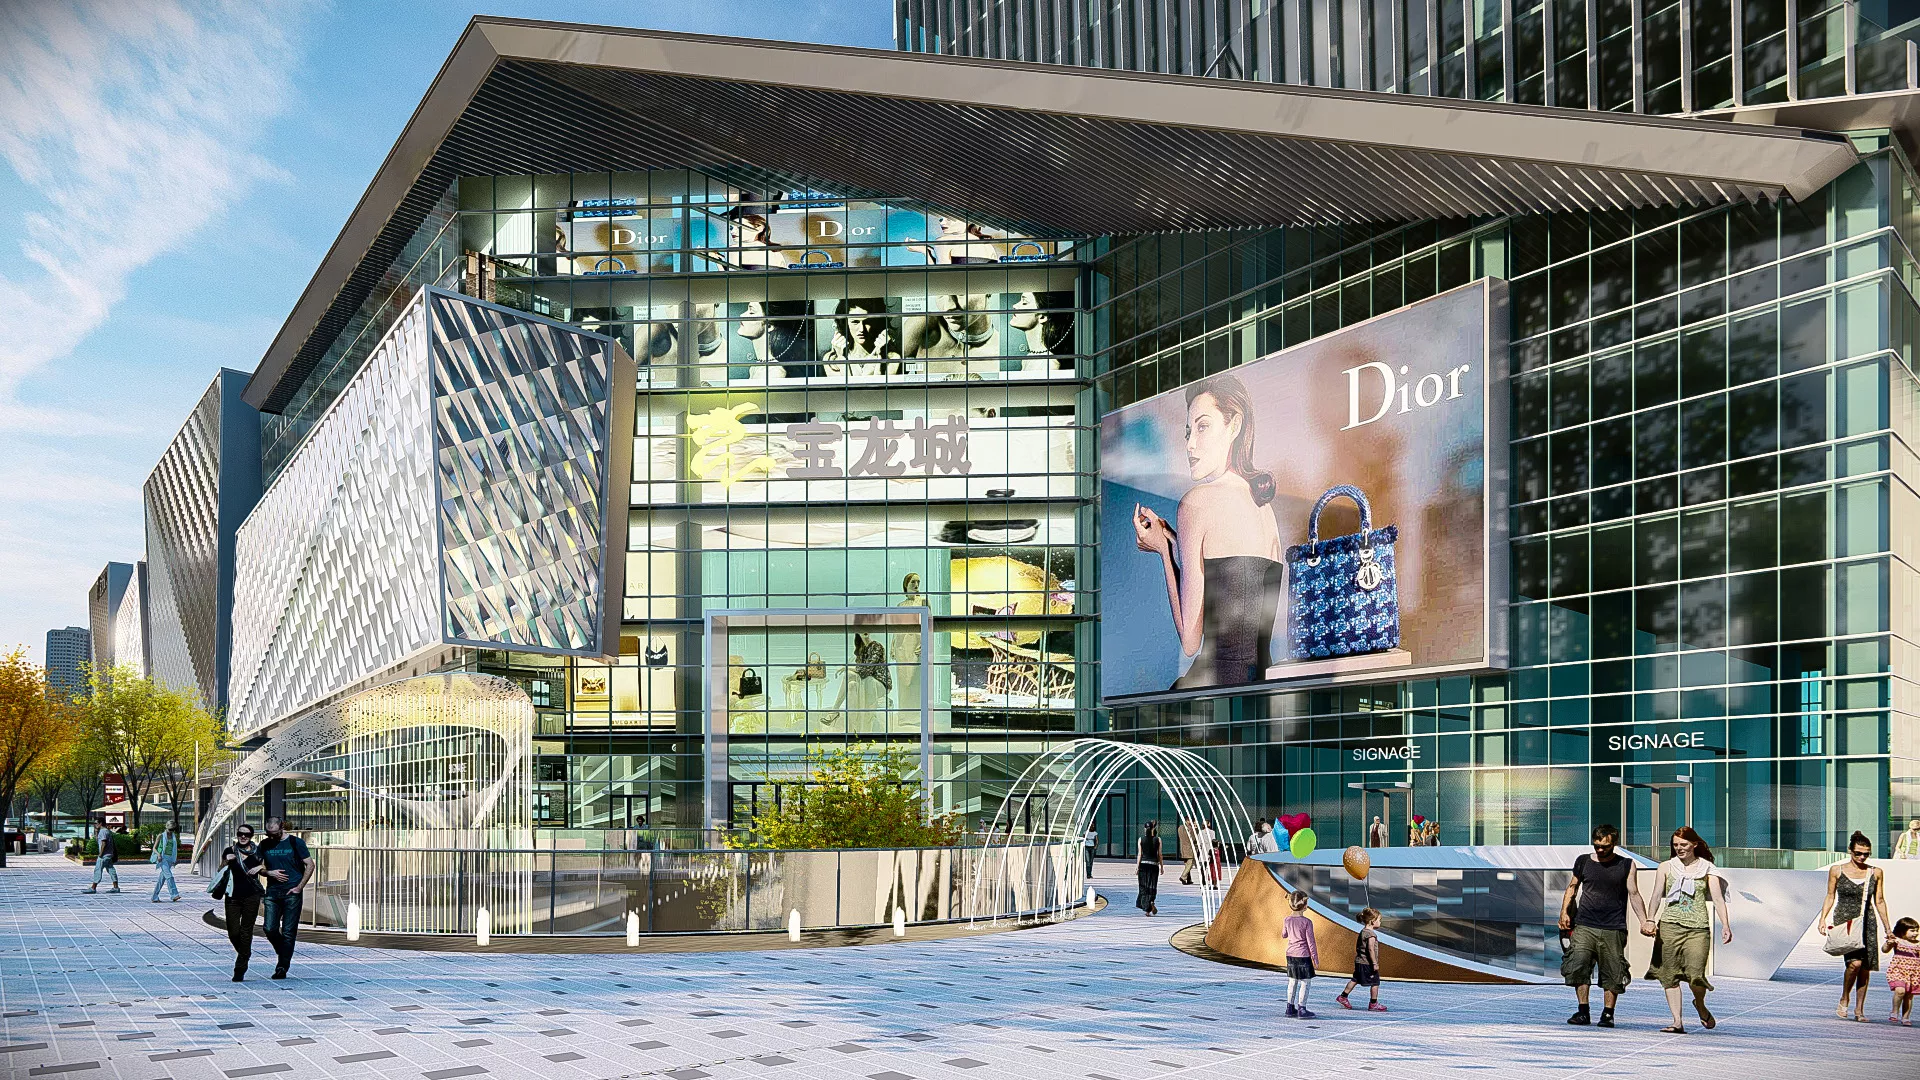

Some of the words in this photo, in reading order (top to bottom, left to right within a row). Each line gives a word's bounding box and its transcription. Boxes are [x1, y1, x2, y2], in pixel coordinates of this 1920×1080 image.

[611, 229, 668, 246] Dior
[816, 220, 876, 238] Dor
[1339, 361, 1470, 431] Dior
[786, 414, 970, 478] 宝龙城
[1607, 731, 1705, 751] SIGNAGE
[1352, 745, 1421, 761] SIGNAGE
